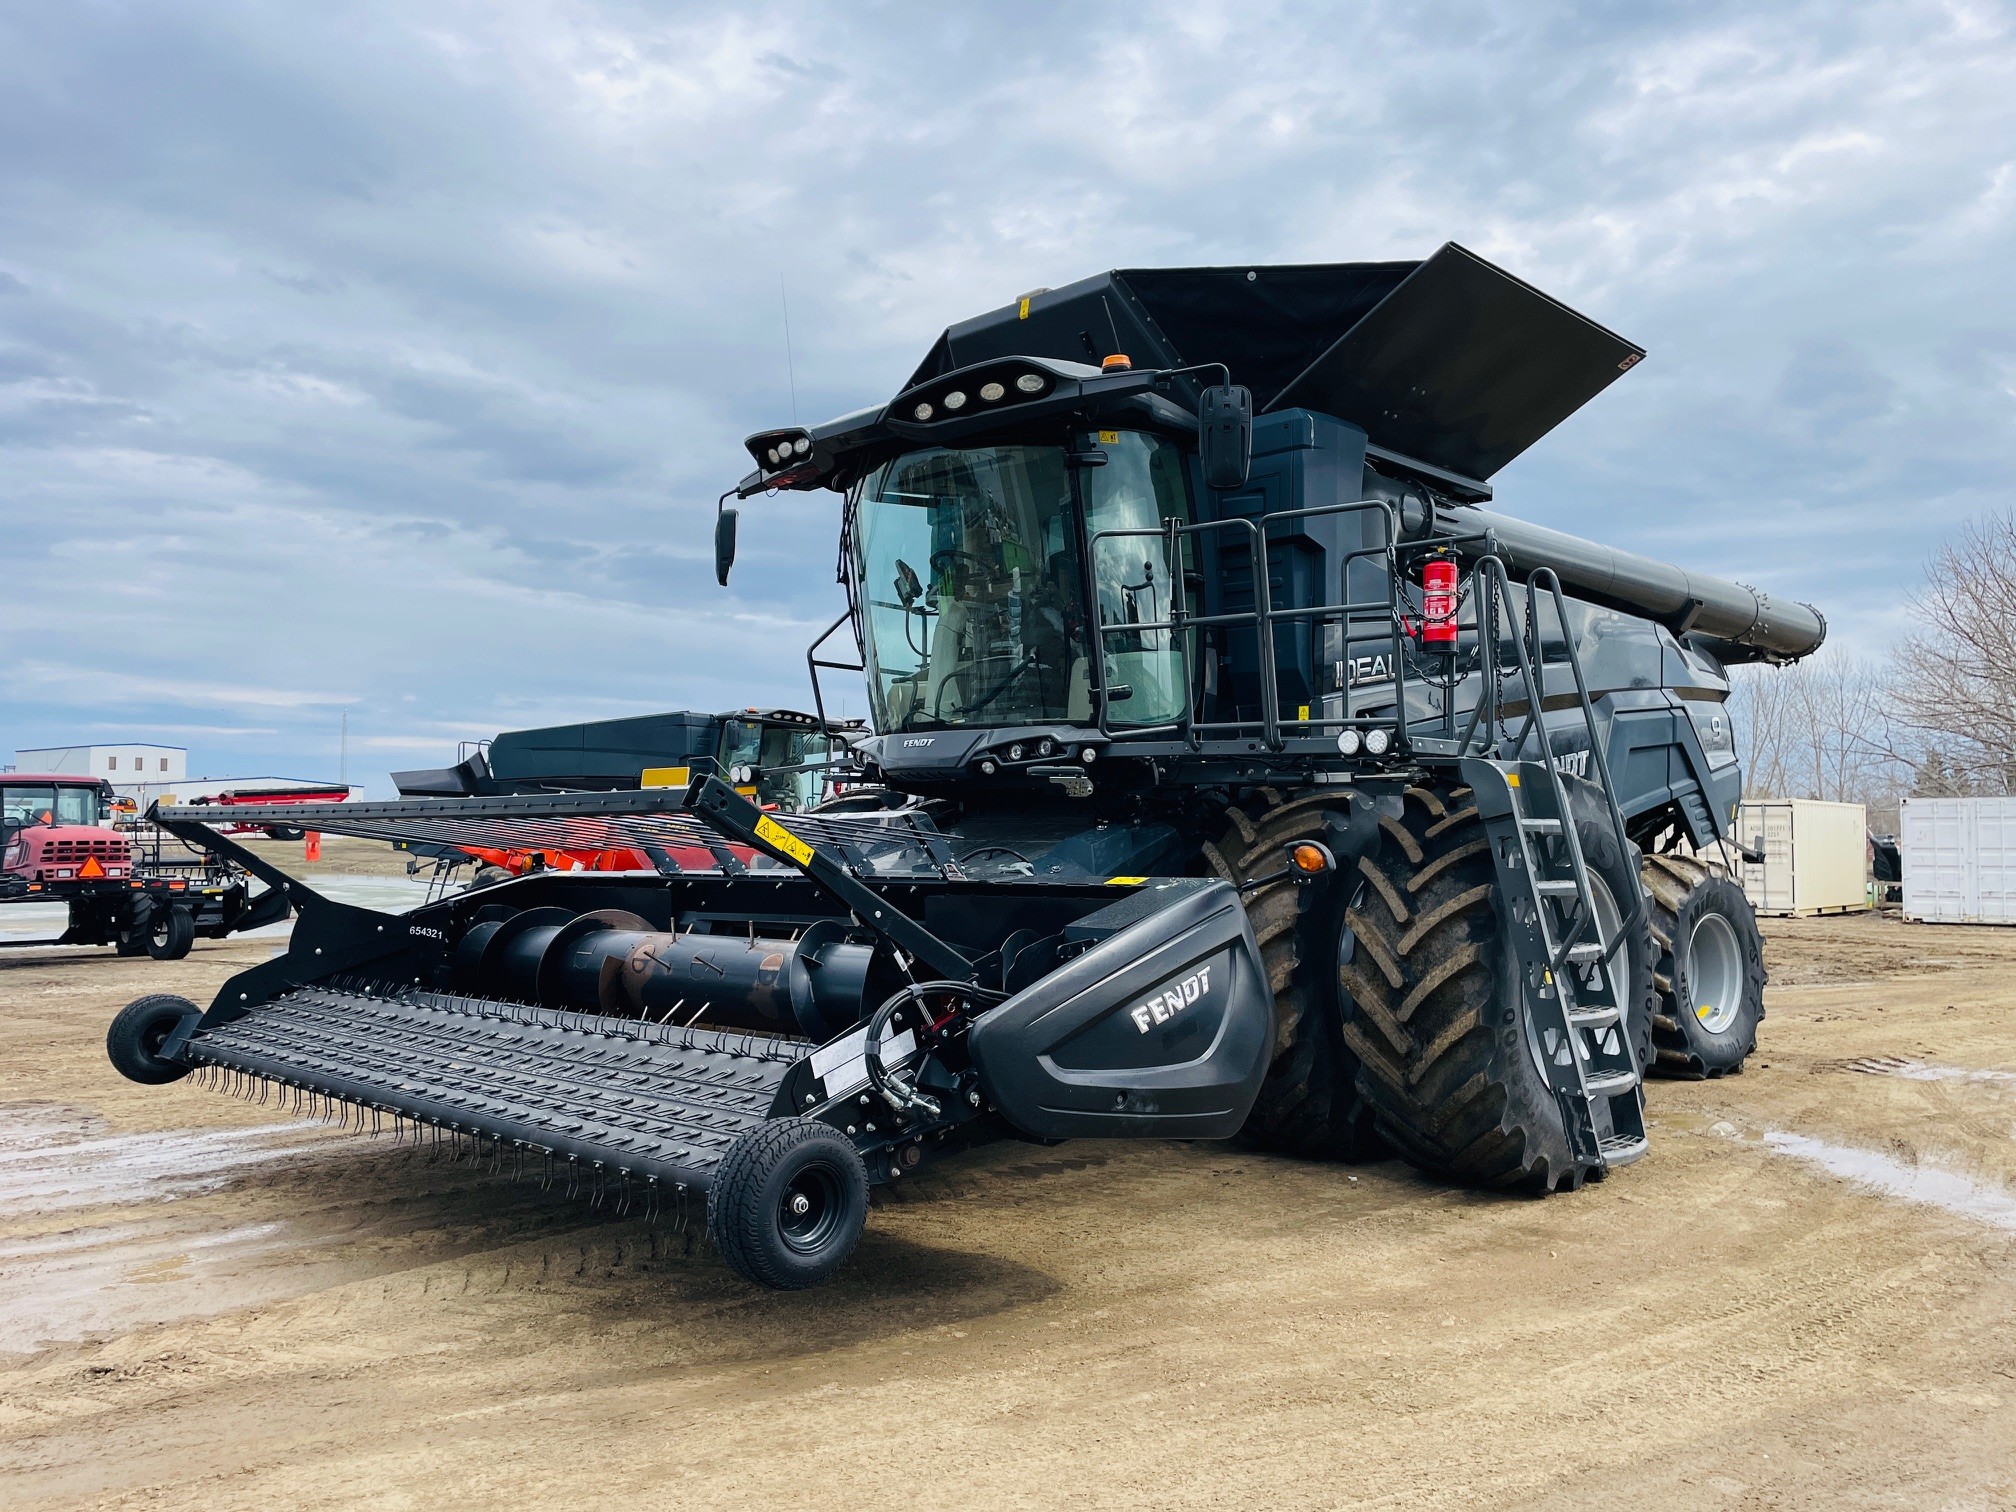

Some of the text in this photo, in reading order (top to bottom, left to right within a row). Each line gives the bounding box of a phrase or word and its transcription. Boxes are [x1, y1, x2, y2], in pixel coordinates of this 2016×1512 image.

[1335, 654, 1396, 688] IDEAL
[903, 738, 935, 748] FENDT
[409, 926, 442, 940] 654321
[1130, 965, 1211, 1035] FENDT
